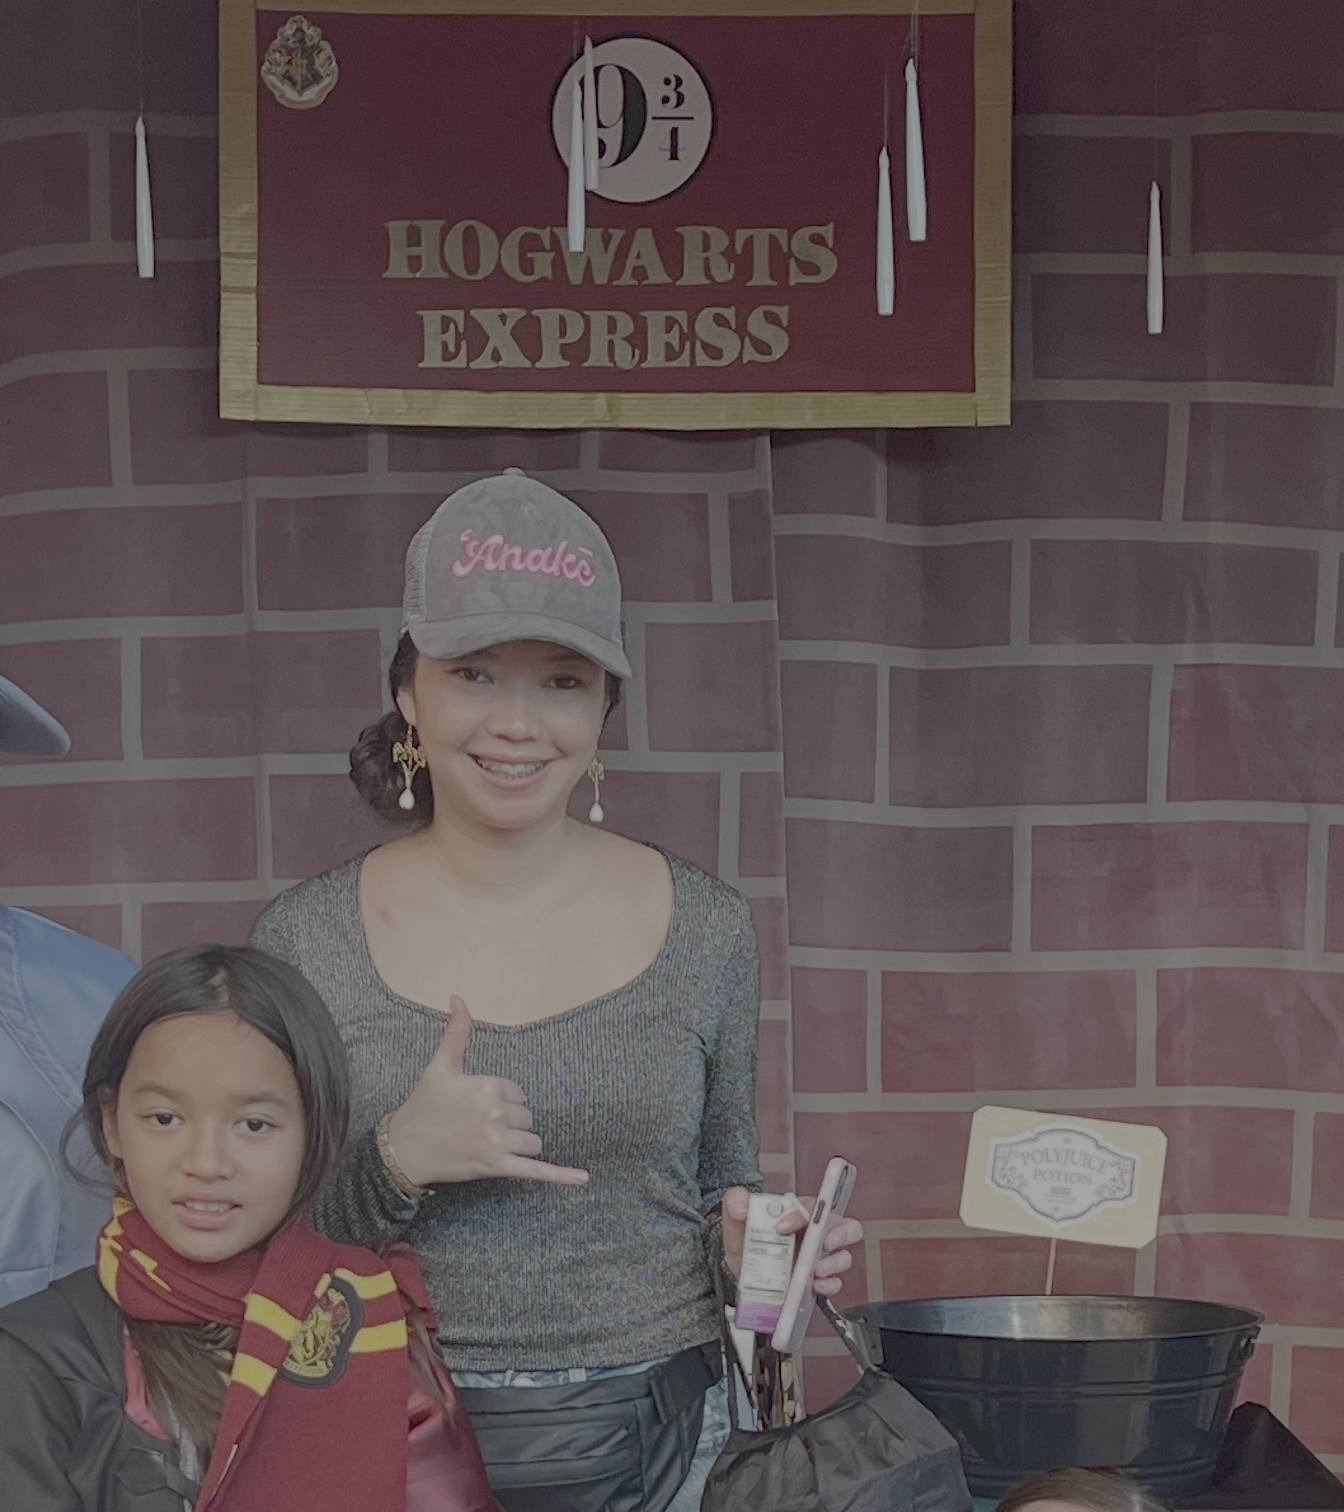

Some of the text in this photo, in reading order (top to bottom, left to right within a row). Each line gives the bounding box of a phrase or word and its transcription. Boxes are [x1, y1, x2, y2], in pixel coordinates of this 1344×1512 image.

[579, 63, 685, 169] 9 3 4
[382, 218, 839, 287] HOGWARTS
[417, 305, 791, 370] EXPRESS
[1020, 1147, 1111, 1175] POLYJUICE
[1032, 1168, 1093, 1186] POTION
